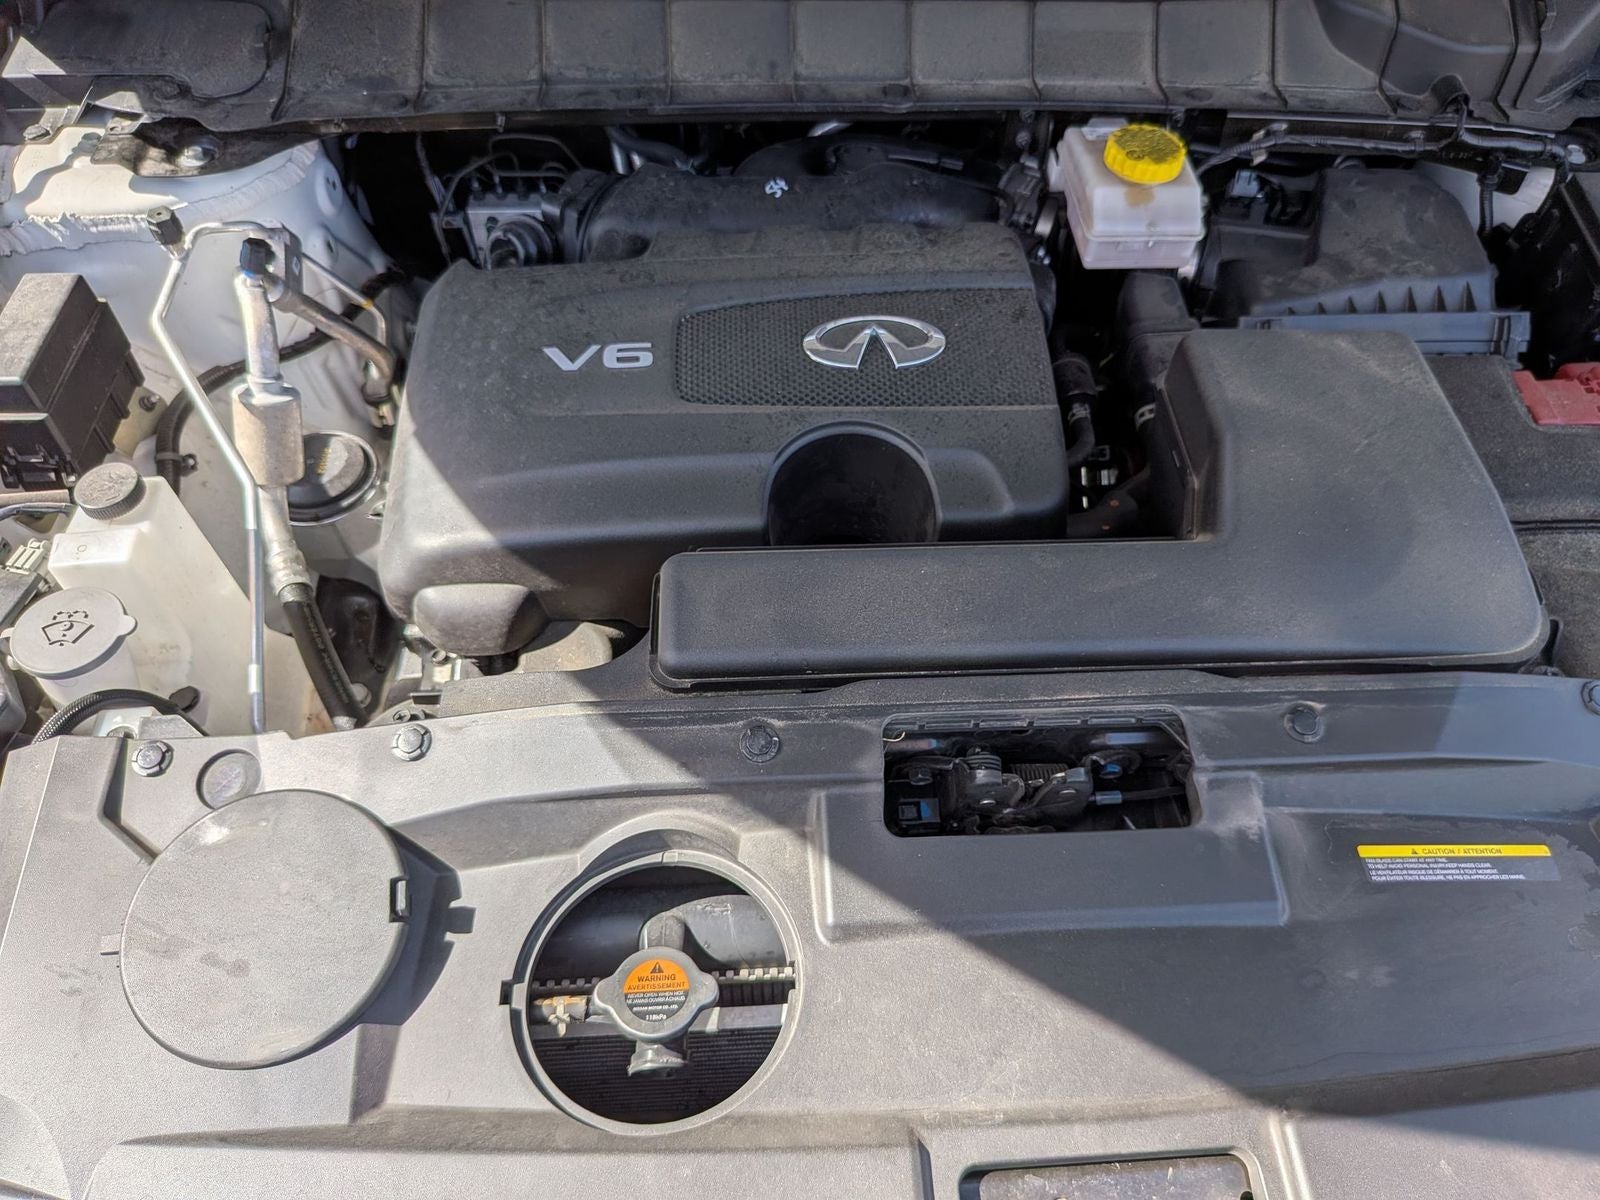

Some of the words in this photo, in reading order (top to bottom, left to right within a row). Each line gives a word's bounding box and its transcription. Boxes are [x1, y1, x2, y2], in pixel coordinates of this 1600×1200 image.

[542, 342, 653, 371] V6
[637, 974, 676, 982] WARNING
[627, 982, 686, 991] AVERTISSEMENT
